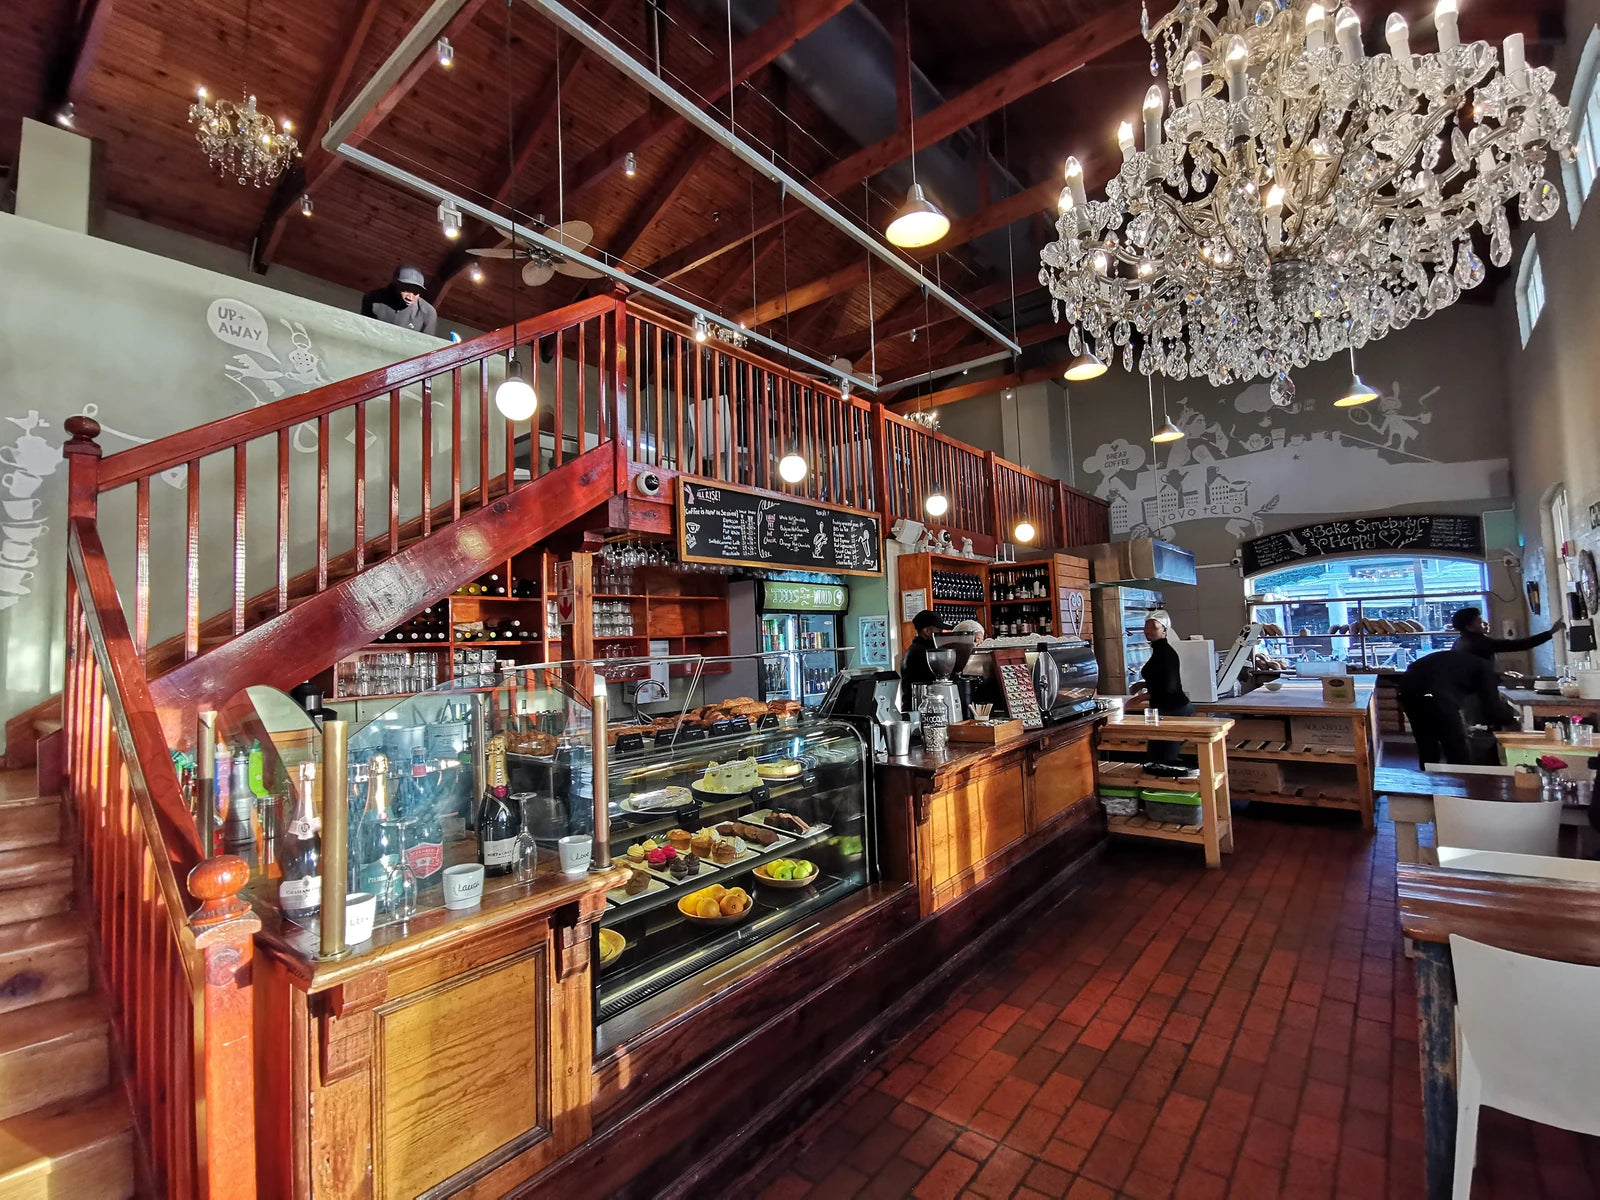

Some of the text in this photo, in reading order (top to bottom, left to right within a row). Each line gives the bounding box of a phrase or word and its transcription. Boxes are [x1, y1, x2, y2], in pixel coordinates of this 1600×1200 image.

[218, 322, 262, 341] AWAY
[1104, 458, 1130, 468] COFFEE
[1106, 451, 1127, 460] BREAD
[1313, 522, 1350, 538] Bake
[1355, 516, 1417, 536] Somebody
[1329, 532, 1377, 550] Happy
